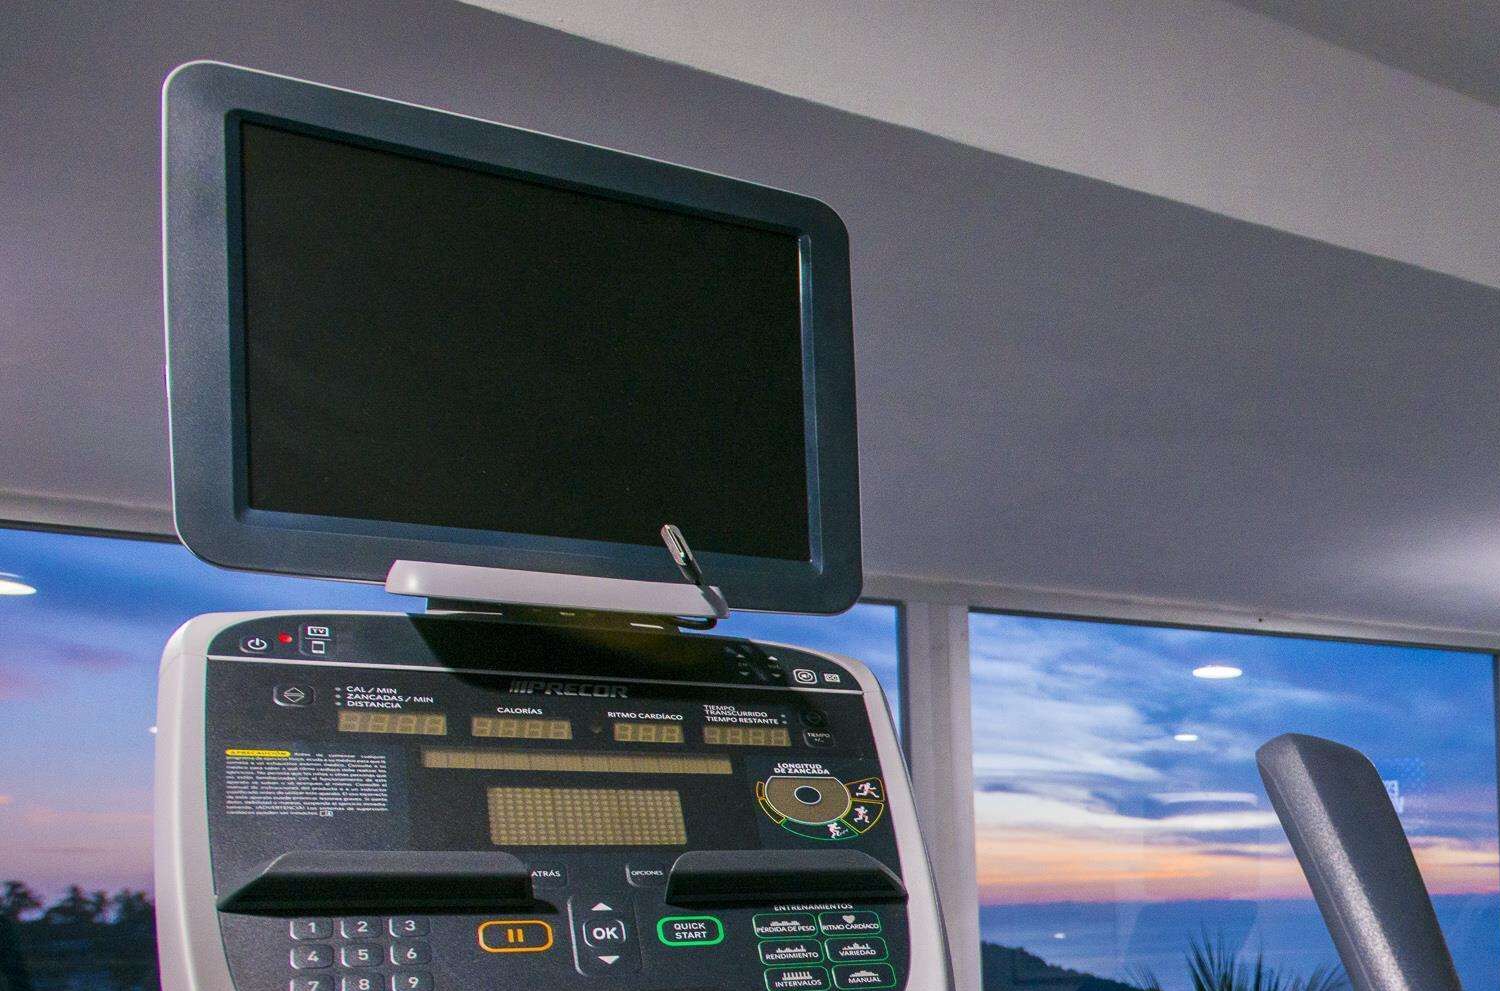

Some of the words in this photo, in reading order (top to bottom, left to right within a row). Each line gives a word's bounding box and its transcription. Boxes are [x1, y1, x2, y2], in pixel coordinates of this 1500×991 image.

[346, 685, 366, 693] CAL
[518, 680, 628, 699] PRECOR
[346, 693, 403, 702] ZANCADAS
[347, 700, 402, 709] DISTANCIA
[497, 707, 543, 715] CALORÍAS
[607, 711, 637, 719] RITMO
[638, 711, 684, 720] CARDÍACO
[705, 710, 768, 718] TRANSCURRIDO
[739, 717, 780, 725] RESTANTE
[777, 762, 822, 770] LONGITUD
[531, 869, 561, 878] ATRÁS
[307, 922, 316, 933] 1
[357, 921, 368, 932] 2
[404, 920, 416, 931] 3
[673, 922, 707, 931] QUICK
[846, 922, 880, 930] CARDÍACO
[592, 926, 620, 940] OK
[675, 931, 708, 940] START
[307, 950, 319, 962] 4
[358, 949, 369, 960] 5
[406, 948, 417, 959] 6
[765, 952, 819, 960] RENDIMIENTO
[838, 949, 877, 957] VARIEDAD
[358, 978, 370, 990] 8
[408, 977, 419, 988] 9
[774, 979, 822, 988] INTERVALOS
